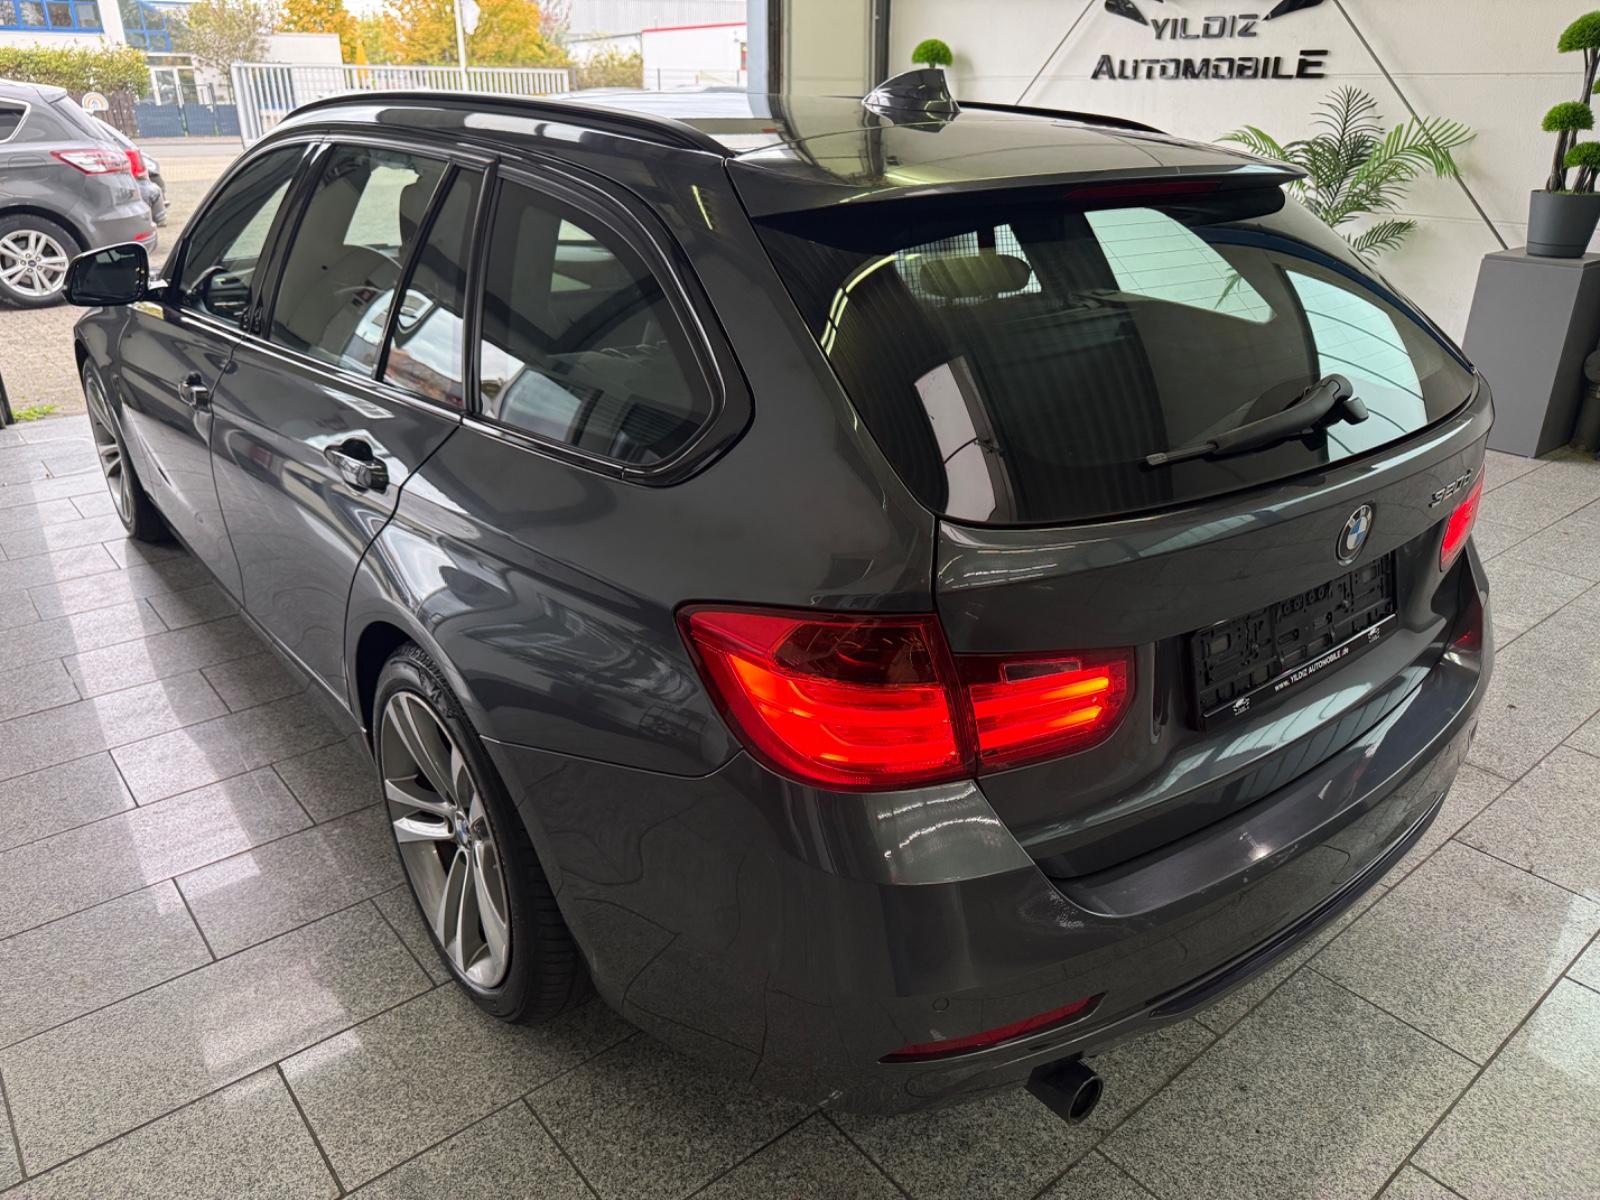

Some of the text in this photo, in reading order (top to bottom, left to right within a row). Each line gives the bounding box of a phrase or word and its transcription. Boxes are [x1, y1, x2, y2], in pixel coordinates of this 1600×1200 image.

[1150, 14, 1259, 40] YILDIZ
[1091, 50, 1329, 80] AUTOMOBILE
[1290, 668, 1308, 683] YILDIZ
[1308, 650, 1341, 674] AUTOMOBILE
